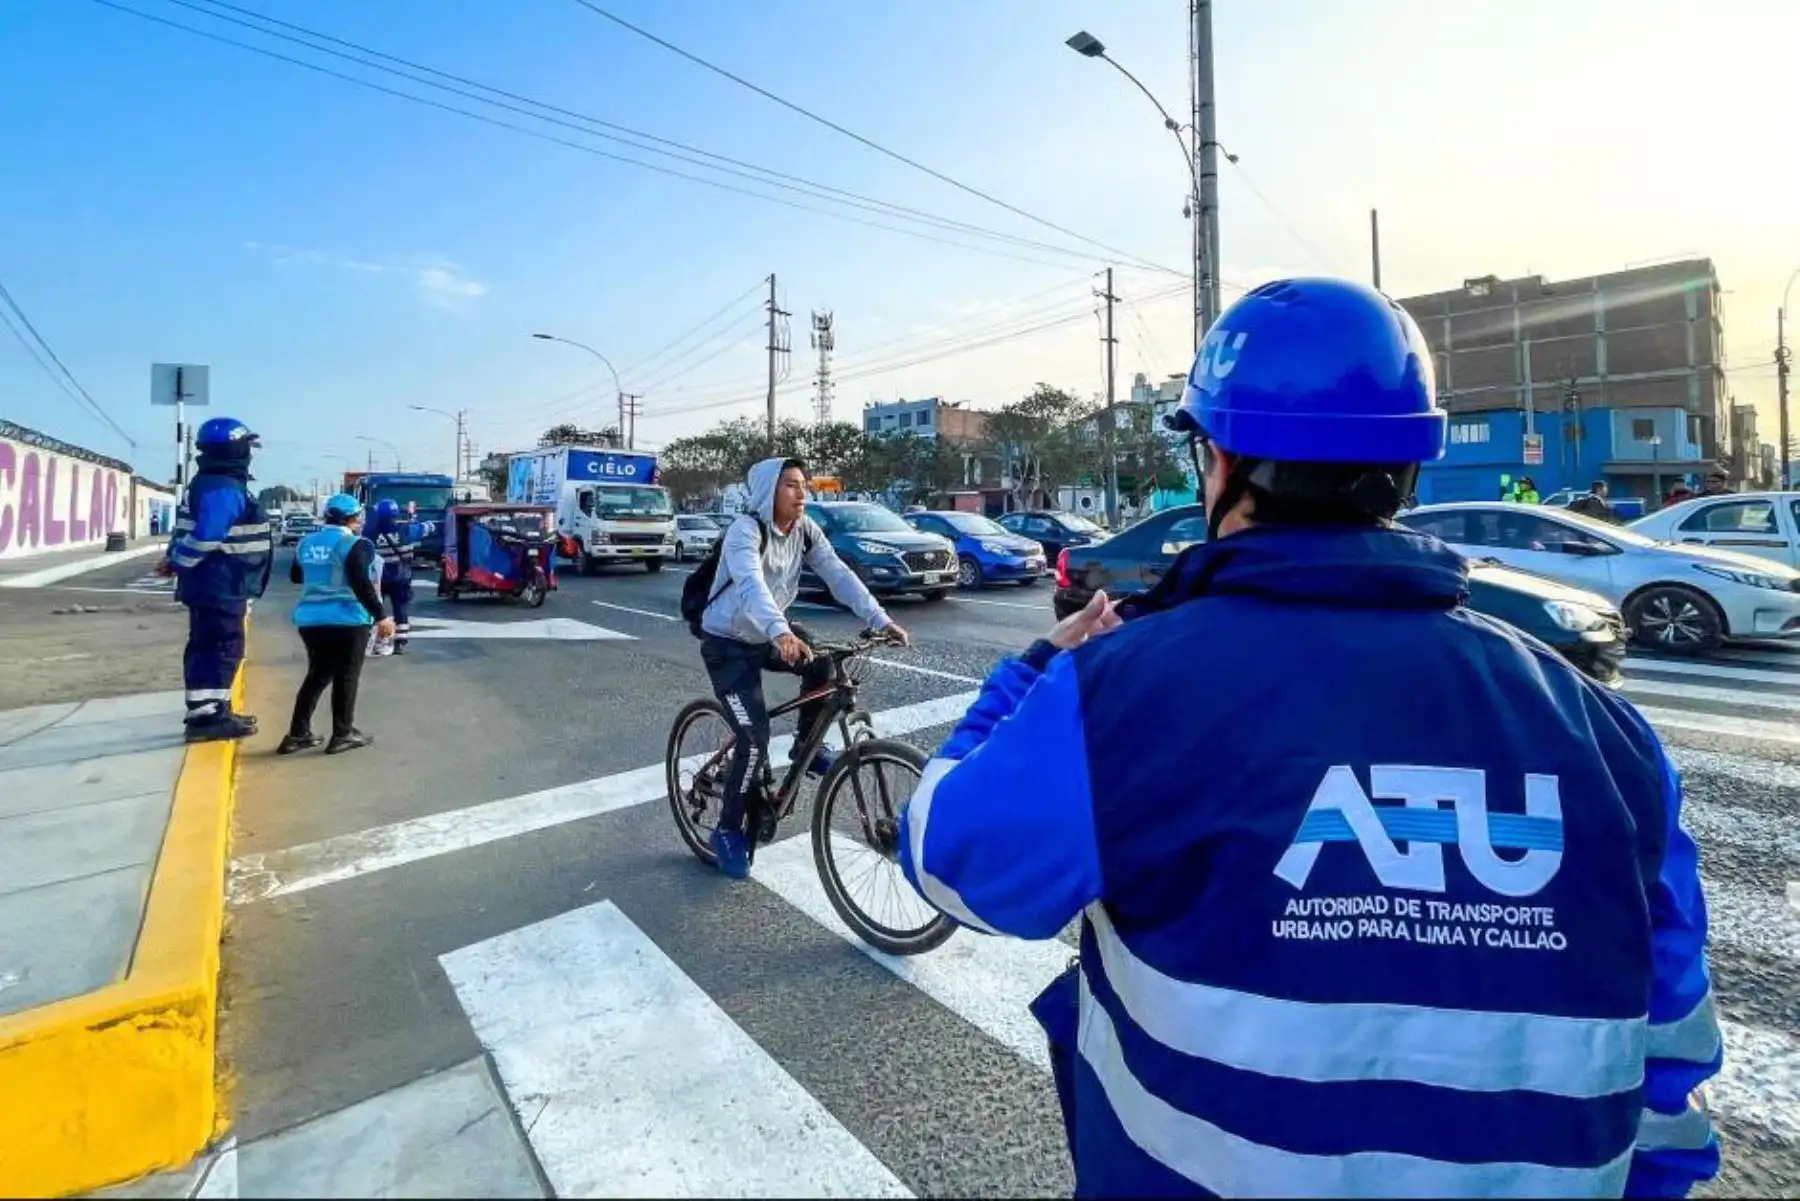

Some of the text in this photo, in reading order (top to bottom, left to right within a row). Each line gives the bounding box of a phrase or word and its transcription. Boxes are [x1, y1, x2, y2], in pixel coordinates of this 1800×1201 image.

[587, 460, 636, 475] CIELO
[726, 693, 752, 726] NIKE
[1273, 765, 1564, 897] ATU
[1285, 896, 1555, 927] AUTORIDAD DE TRANSPORTE
[1272, 919, 1567, 951] URBANO PARA LIMA Y CALLAO
